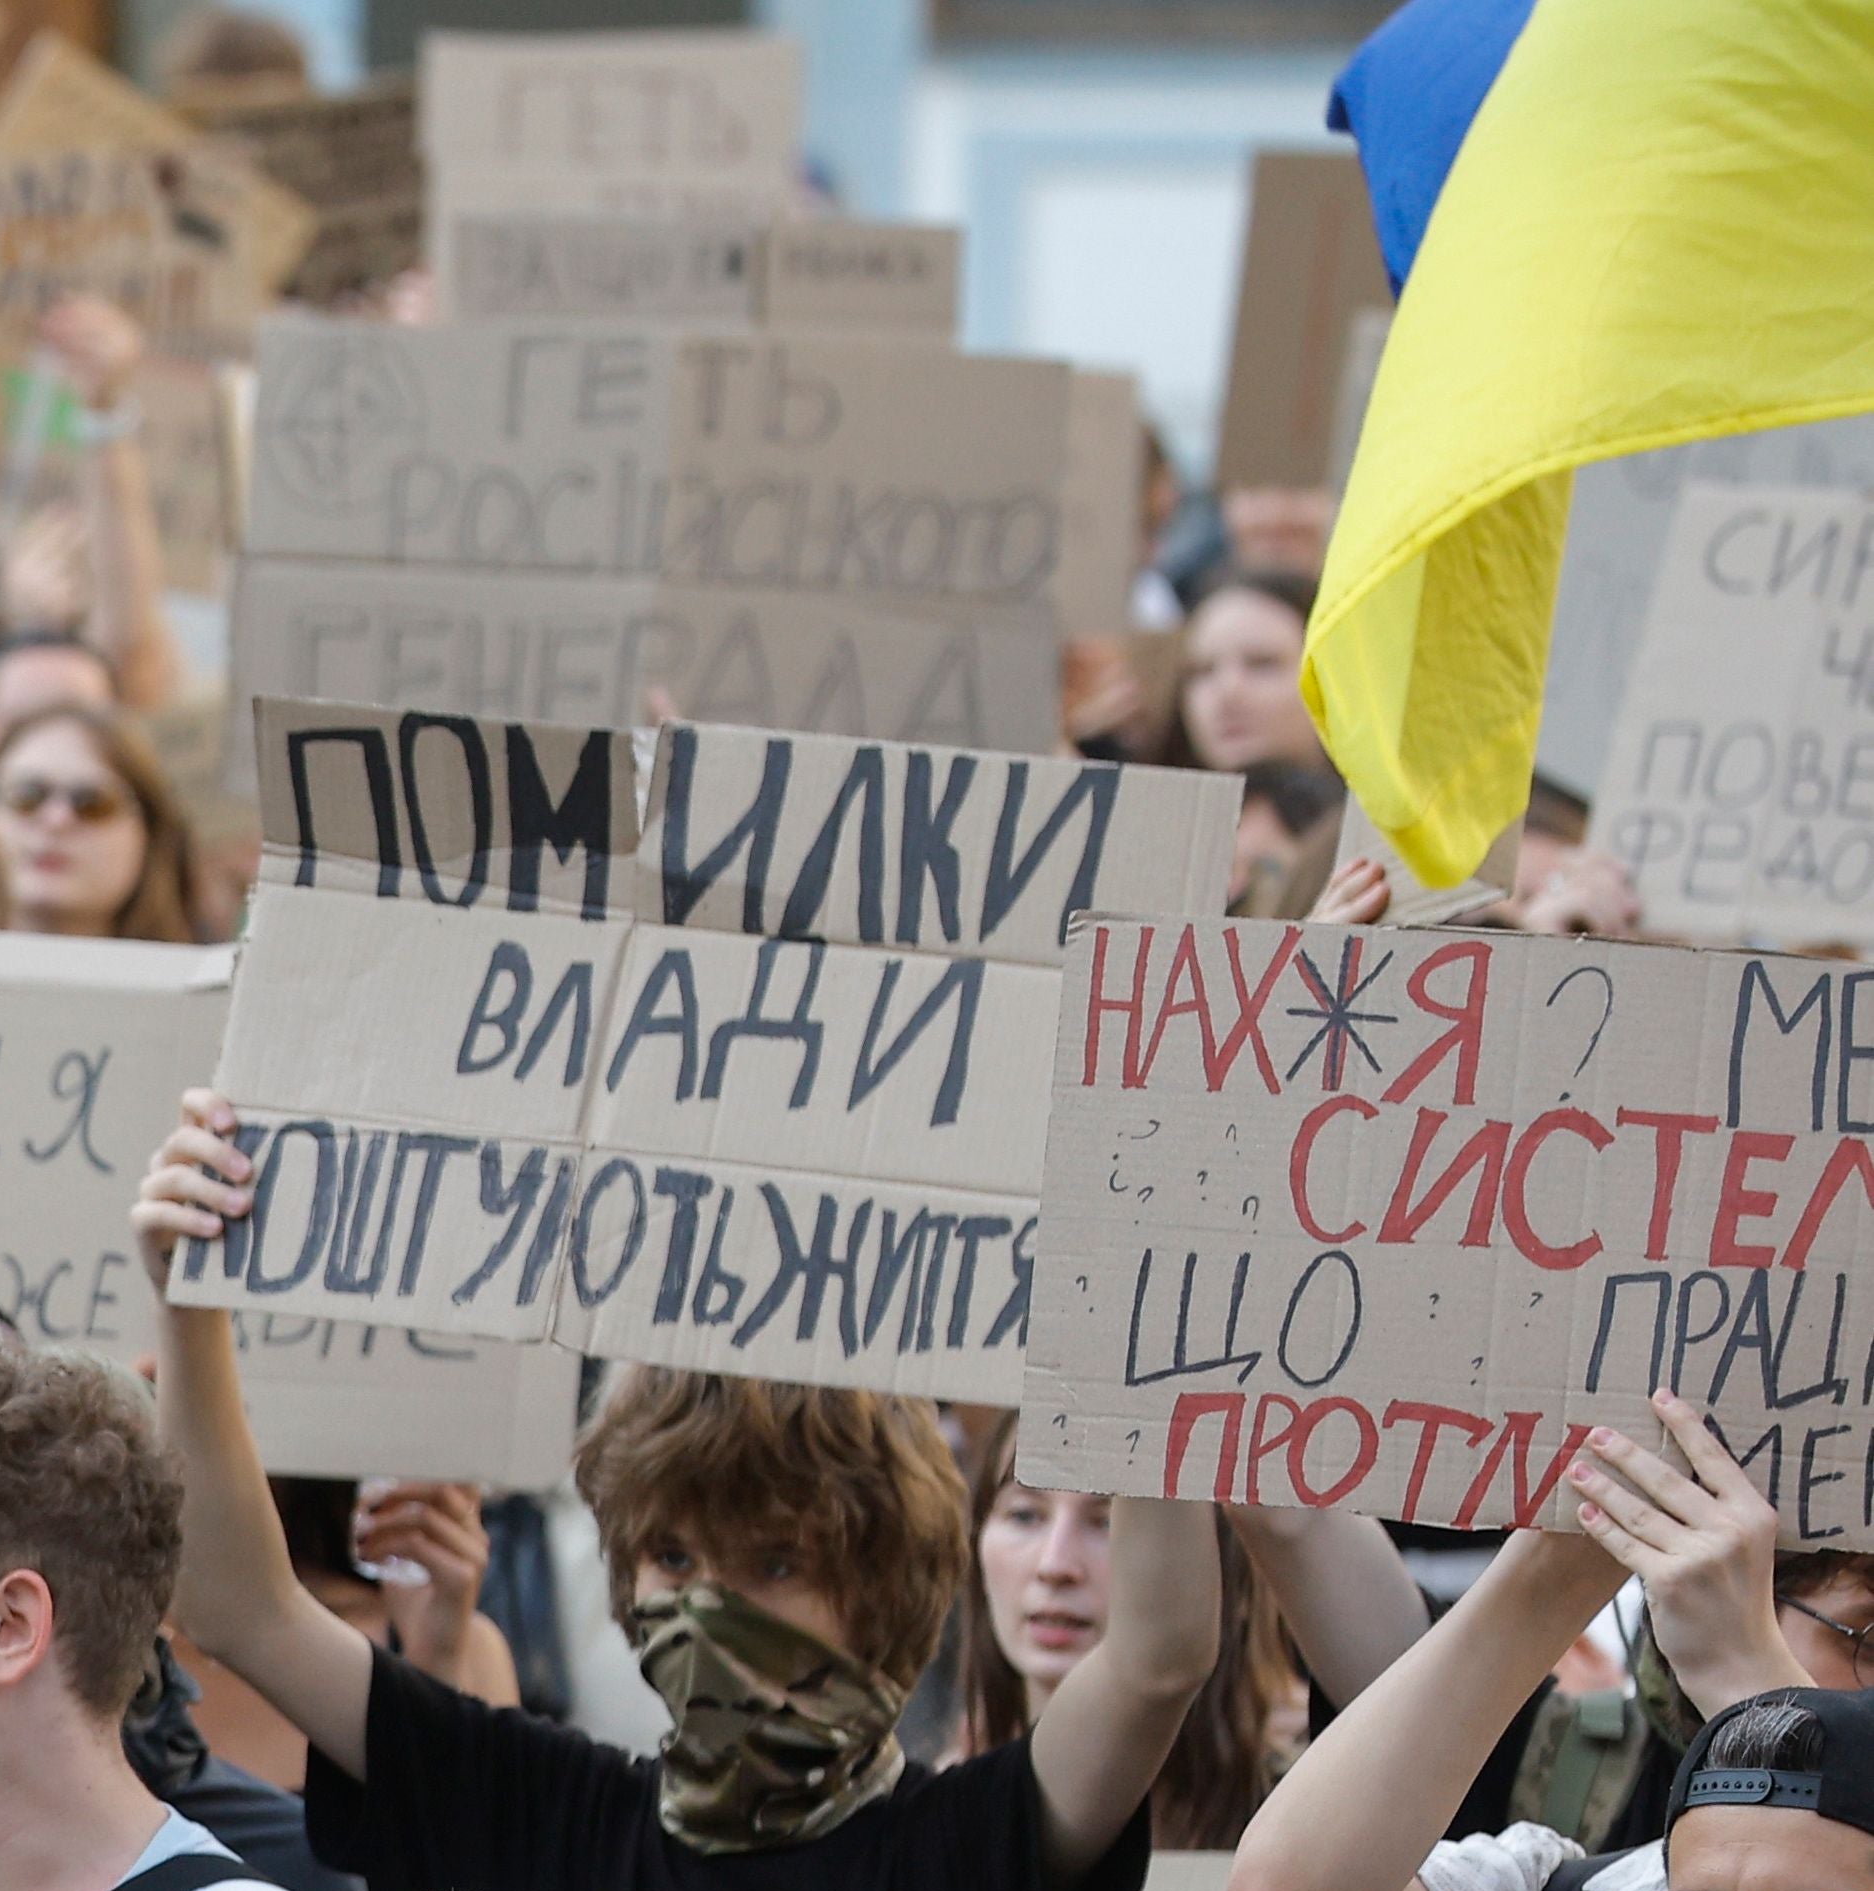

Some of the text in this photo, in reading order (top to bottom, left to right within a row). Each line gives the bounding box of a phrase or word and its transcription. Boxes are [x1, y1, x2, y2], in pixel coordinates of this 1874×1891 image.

[285, 710, 1124, 946] ПОМИЛКИ
[454, 932, 990, 1130] ВЛАДИ
[1124, 1248, 1366, 1390] ЩО
